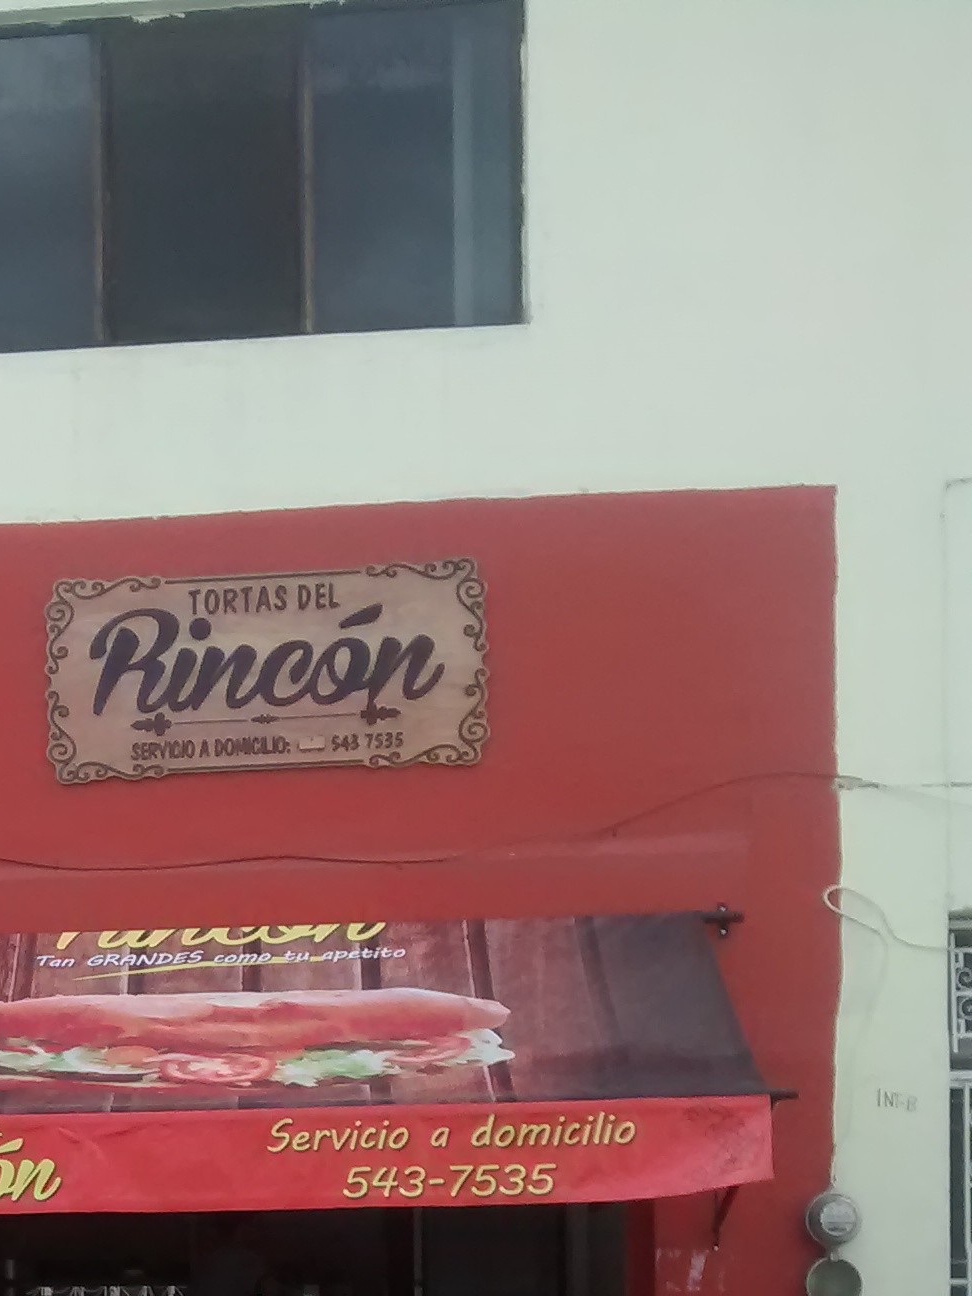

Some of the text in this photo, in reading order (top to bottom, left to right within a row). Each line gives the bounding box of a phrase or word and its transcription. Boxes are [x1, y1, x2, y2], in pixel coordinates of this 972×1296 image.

[188, 582, 341, 616] TORTAS DEL
[89, 603, 445, 716] Rincón
[130, 731, 406, 761] SERVICIO A DOMICILIO: 543 7535
[35, 946, 407, 968] Tan GRANDES como tu apetito
[266, 1110, 637, 1153] Servicio a domicilio
[341, 1162, 558, 1199] 543-7535
